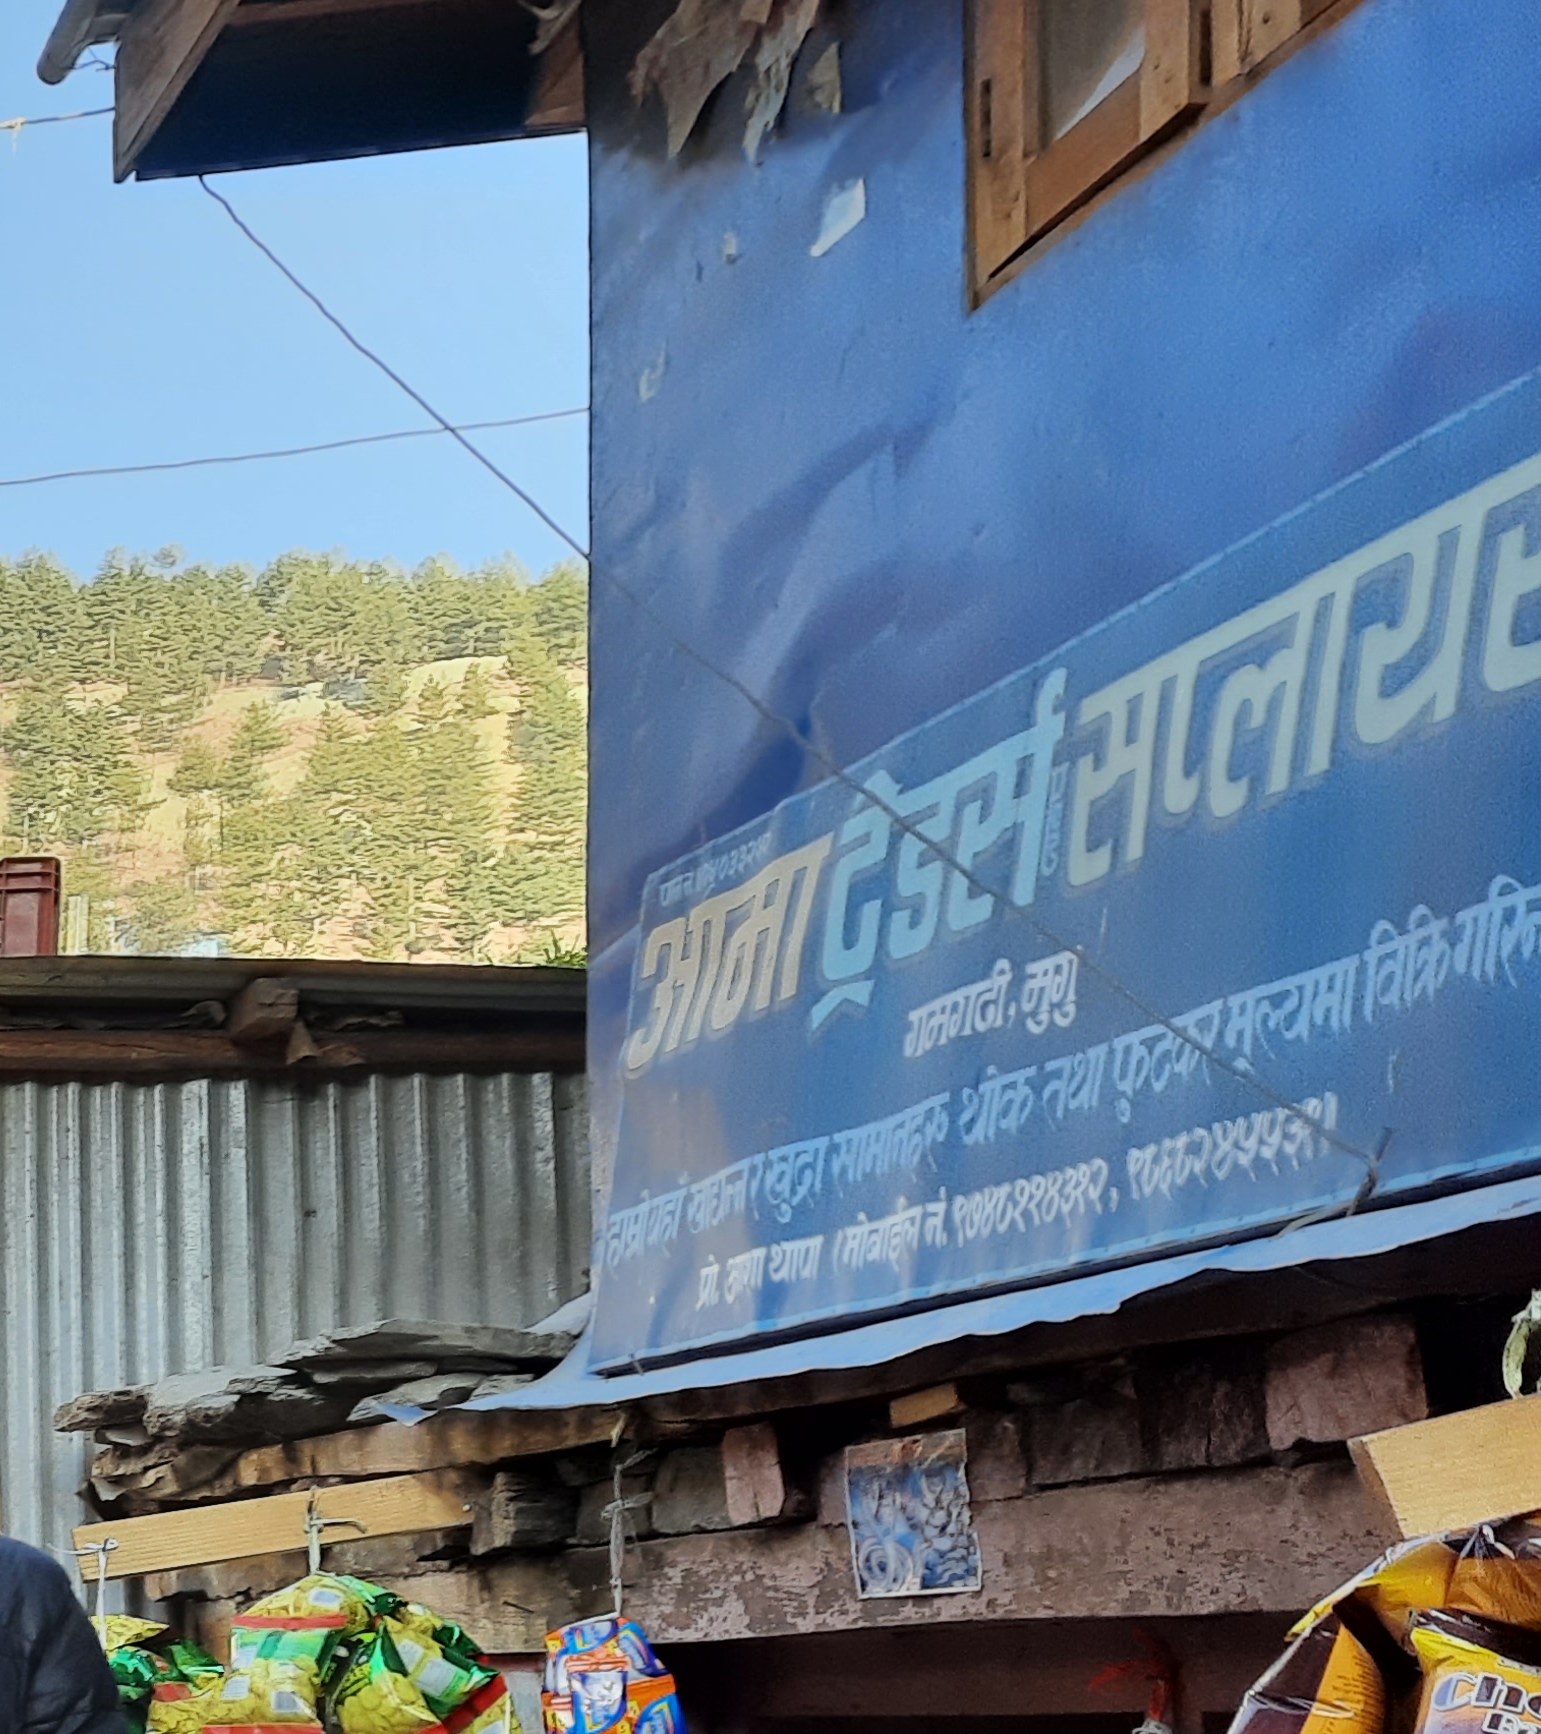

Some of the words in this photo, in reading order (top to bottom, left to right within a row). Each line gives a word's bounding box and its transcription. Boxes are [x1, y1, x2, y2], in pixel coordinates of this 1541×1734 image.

[626, 831, 834, 1070] आमा
[812, 667, 1066, 1031] ट्रेडर्स
[1042, 1043, 1107, 1128] तथा
